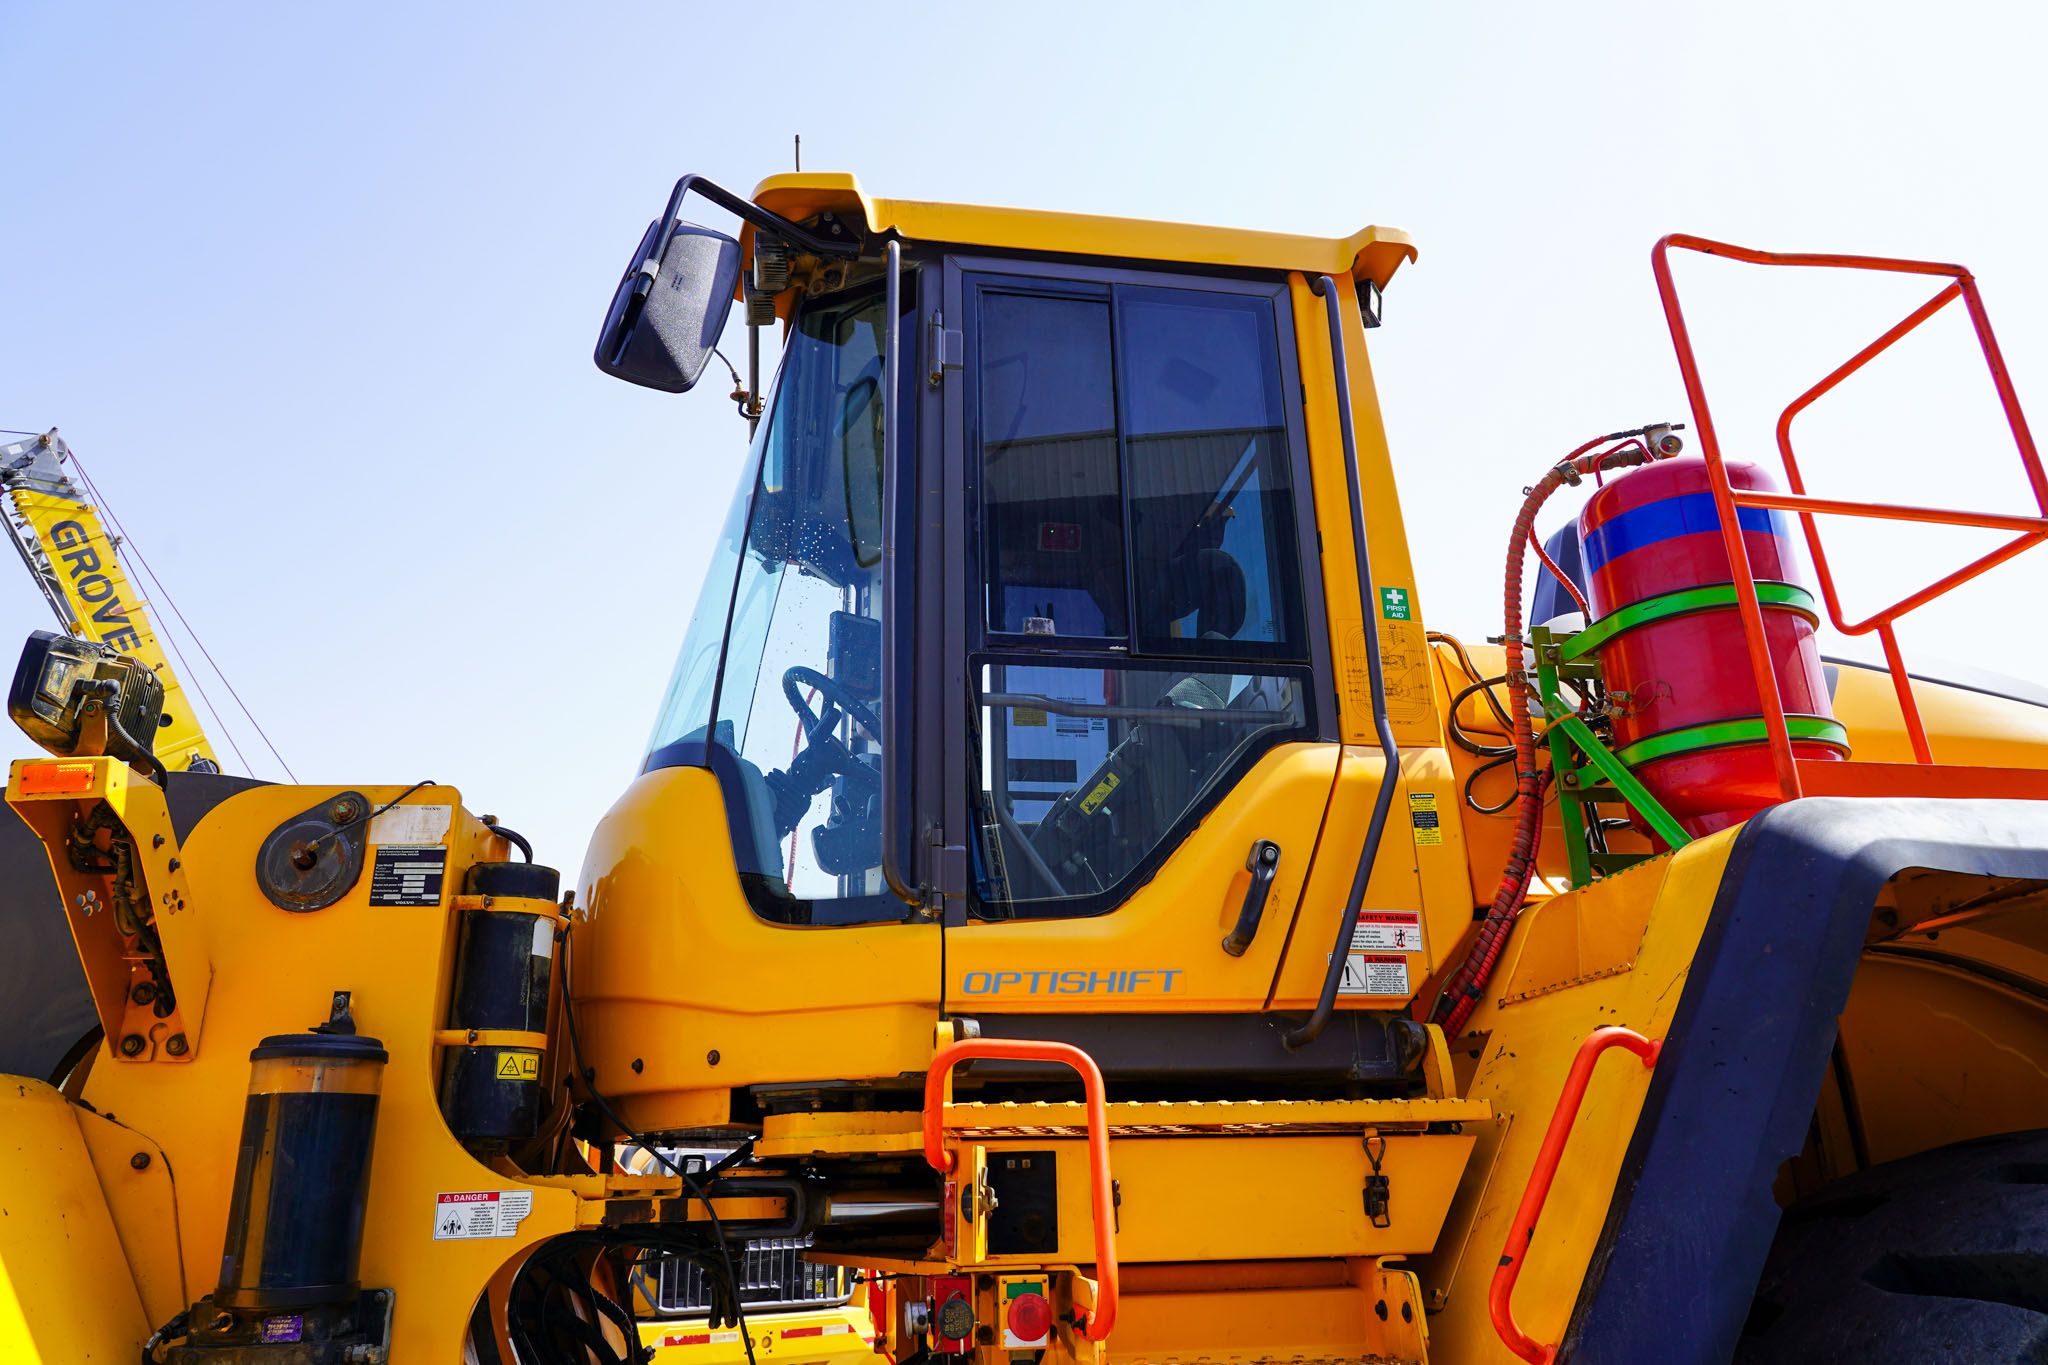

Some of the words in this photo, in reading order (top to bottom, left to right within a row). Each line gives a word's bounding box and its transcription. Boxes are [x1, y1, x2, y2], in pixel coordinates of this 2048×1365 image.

[50, 520, 142, 652] GROVE
[1386, 604, 1407, 612] FIRST
[962, 969, 1184, 994] OPTISHIFT
[453, 1194, 488, 1202] DANGER
